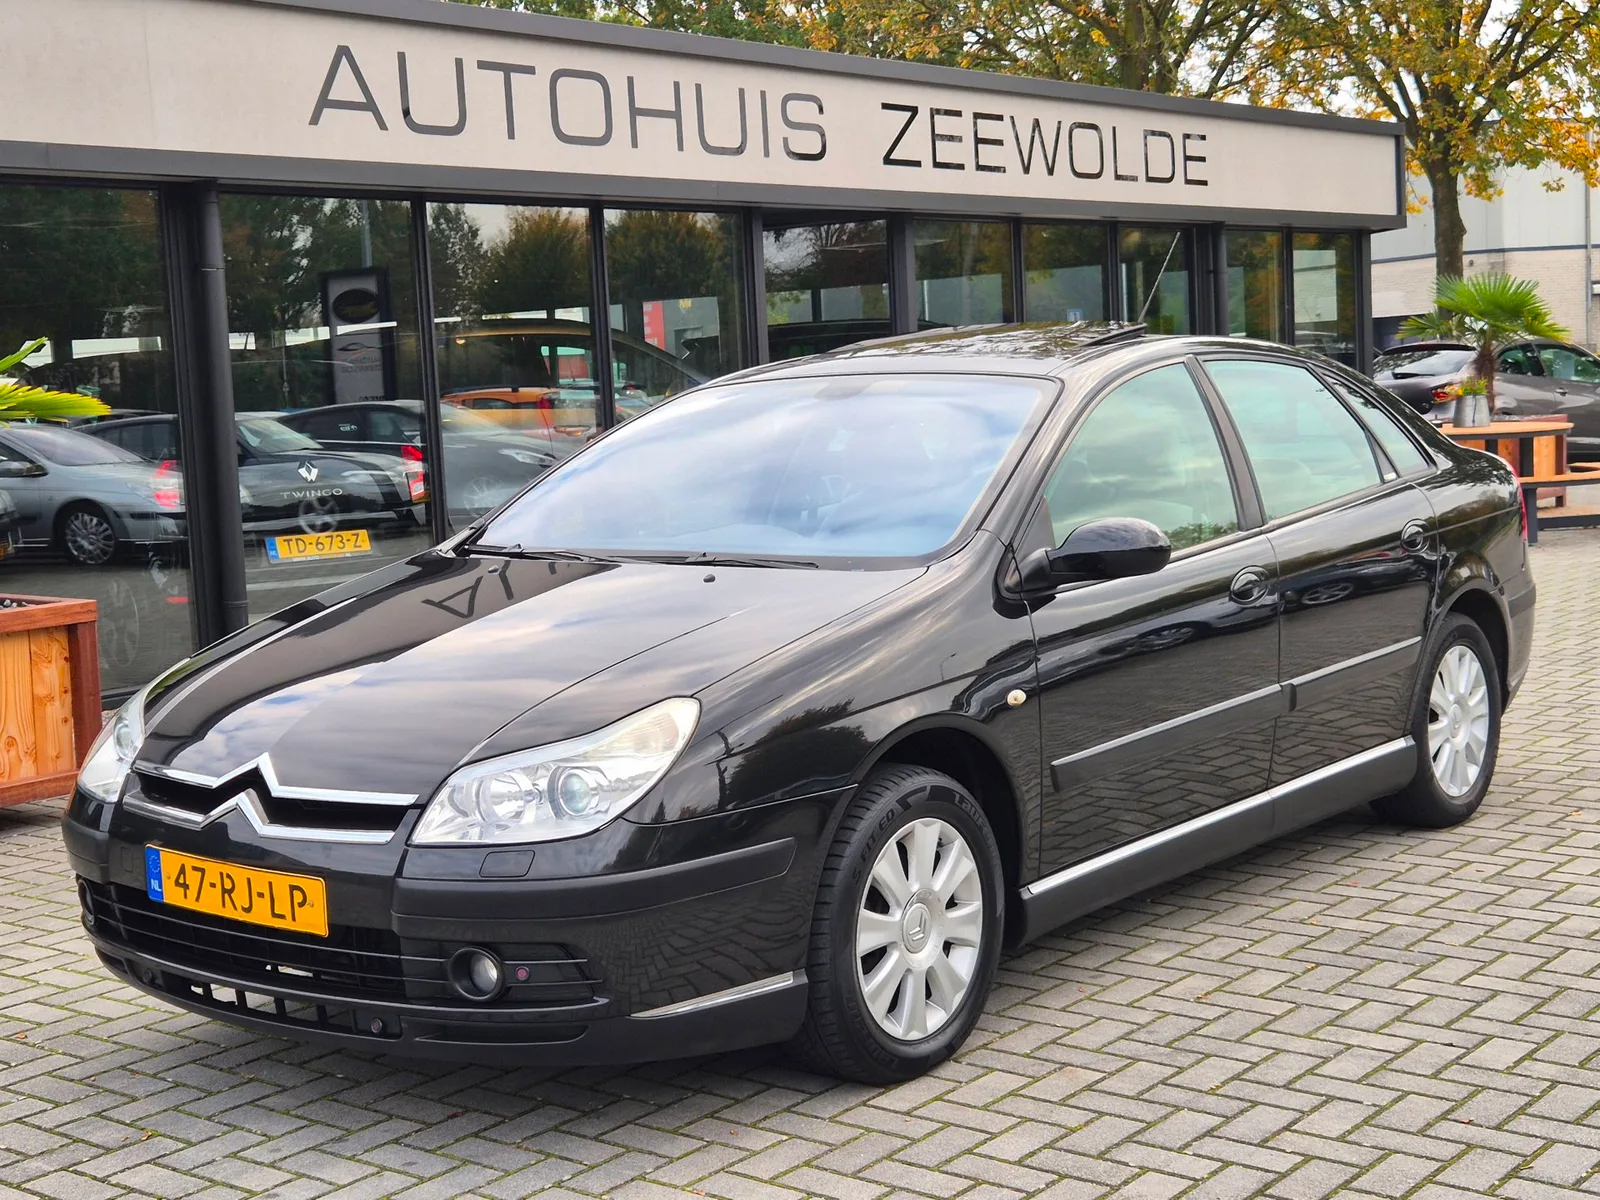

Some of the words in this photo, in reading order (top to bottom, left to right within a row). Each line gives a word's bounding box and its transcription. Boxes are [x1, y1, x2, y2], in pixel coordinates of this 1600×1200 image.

[308, 44, 827, 161] AUTOHUIS
[880, 102, 1208, 187] ZEEWOLDE
[280, 488, 343, 500] TWINGO
[283, 532, 363, 555] TD-673-Z
[150, 878, 162, 892] NL
[174, 863, 308, 922] 47-RJ-LP
